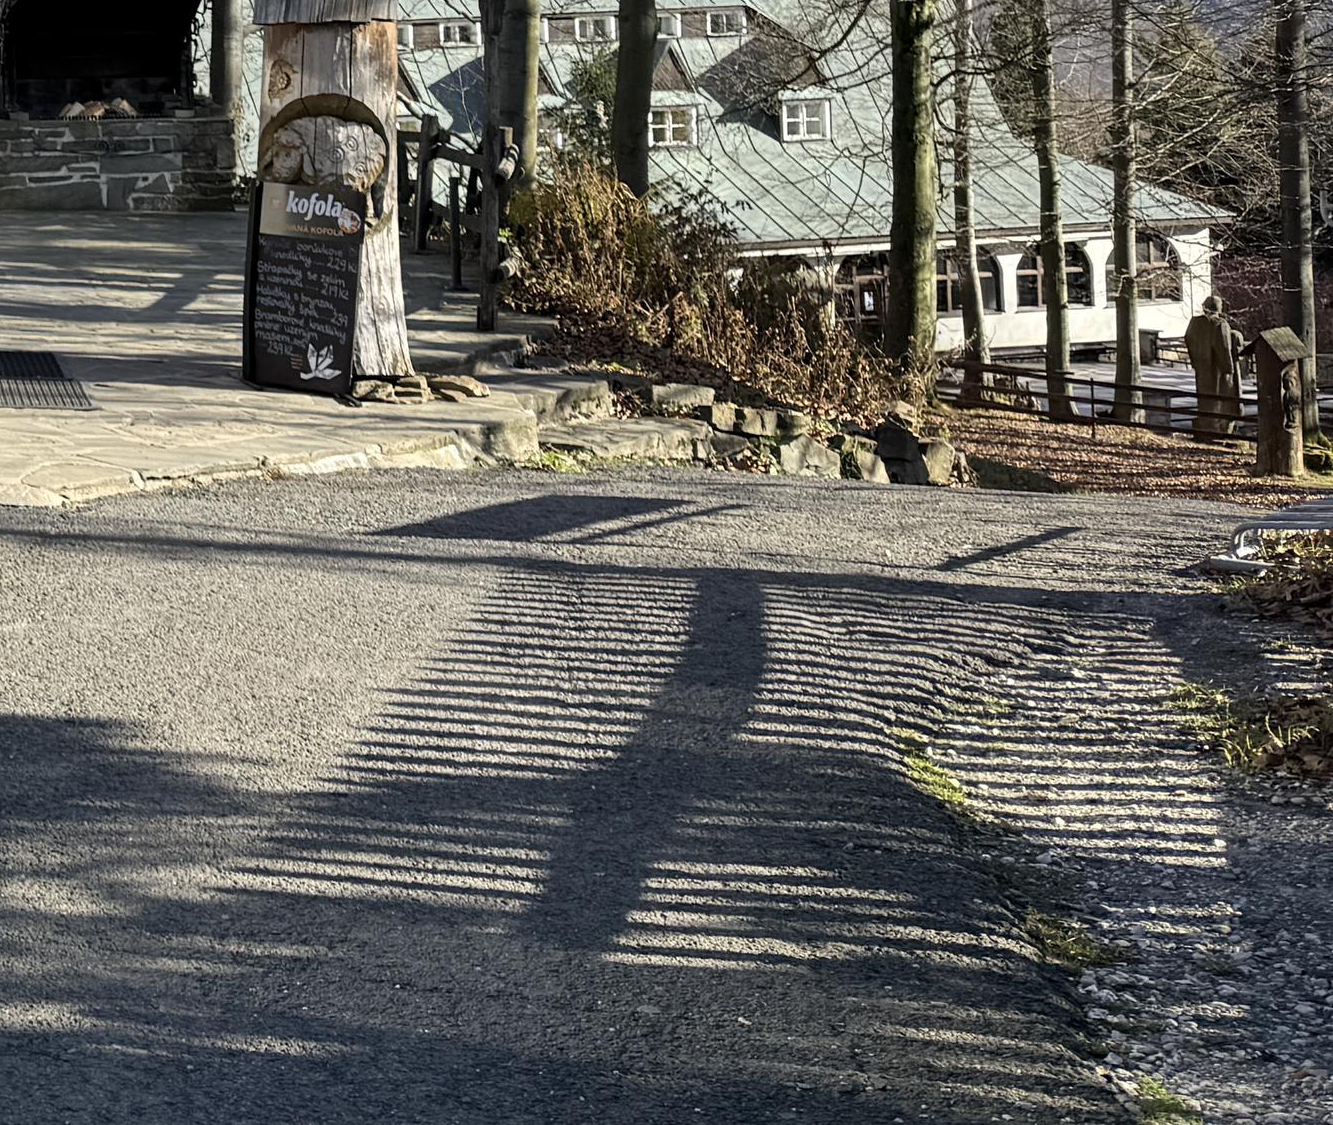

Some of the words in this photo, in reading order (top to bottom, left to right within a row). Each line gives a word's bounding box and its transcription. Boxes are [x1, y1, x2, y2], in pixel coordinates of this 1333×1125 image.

[286, 190, 343, 221] kofola
[310, 226, 345, 237] KOFOLA
[327, 257, 346, 272] 229
[320, 283, 338, 297] 219
